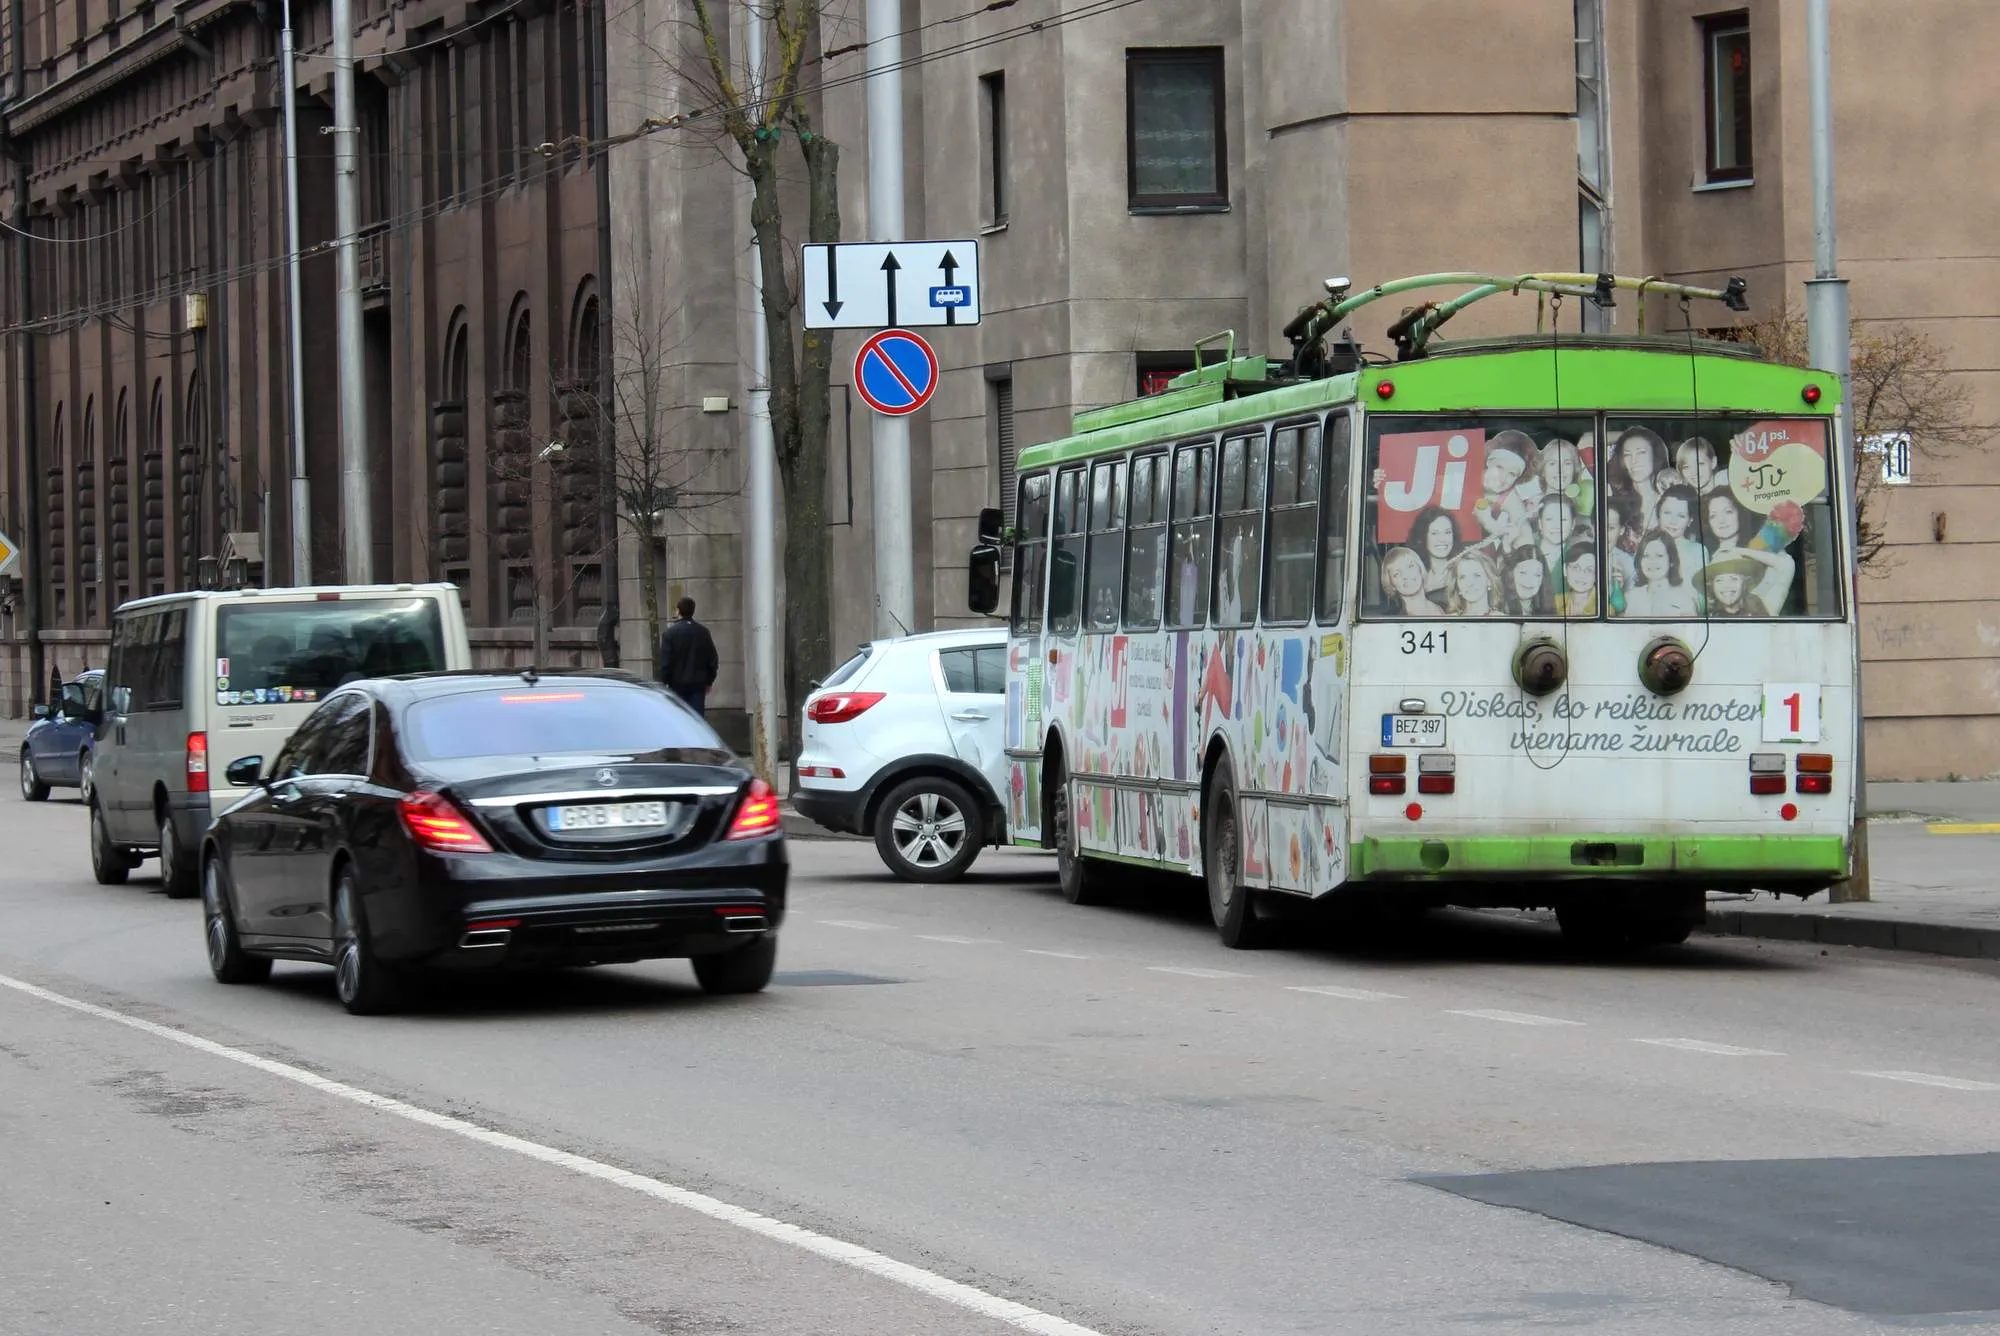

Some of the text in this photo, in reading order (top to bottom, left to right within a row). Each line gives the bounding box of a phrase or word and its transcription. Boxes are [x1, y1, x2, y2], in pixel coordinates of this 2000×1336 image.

[1745, 430, 1790, 455] 64 psl.
[1885, 440, 1907, 477] 10
[1384, 434, 1469, 512] Ji
[1754, 488, 1791, 504] programa
[1401, 630, 1449, 654] 341
[1441, 691, 1762, 722] Viskas, ko reikia moter
[1783, 692, 1800, 732] 1
[1396, 719, 1441, 734] BEZ 397
[1510, 724, 1741, 752] viename žurnale
